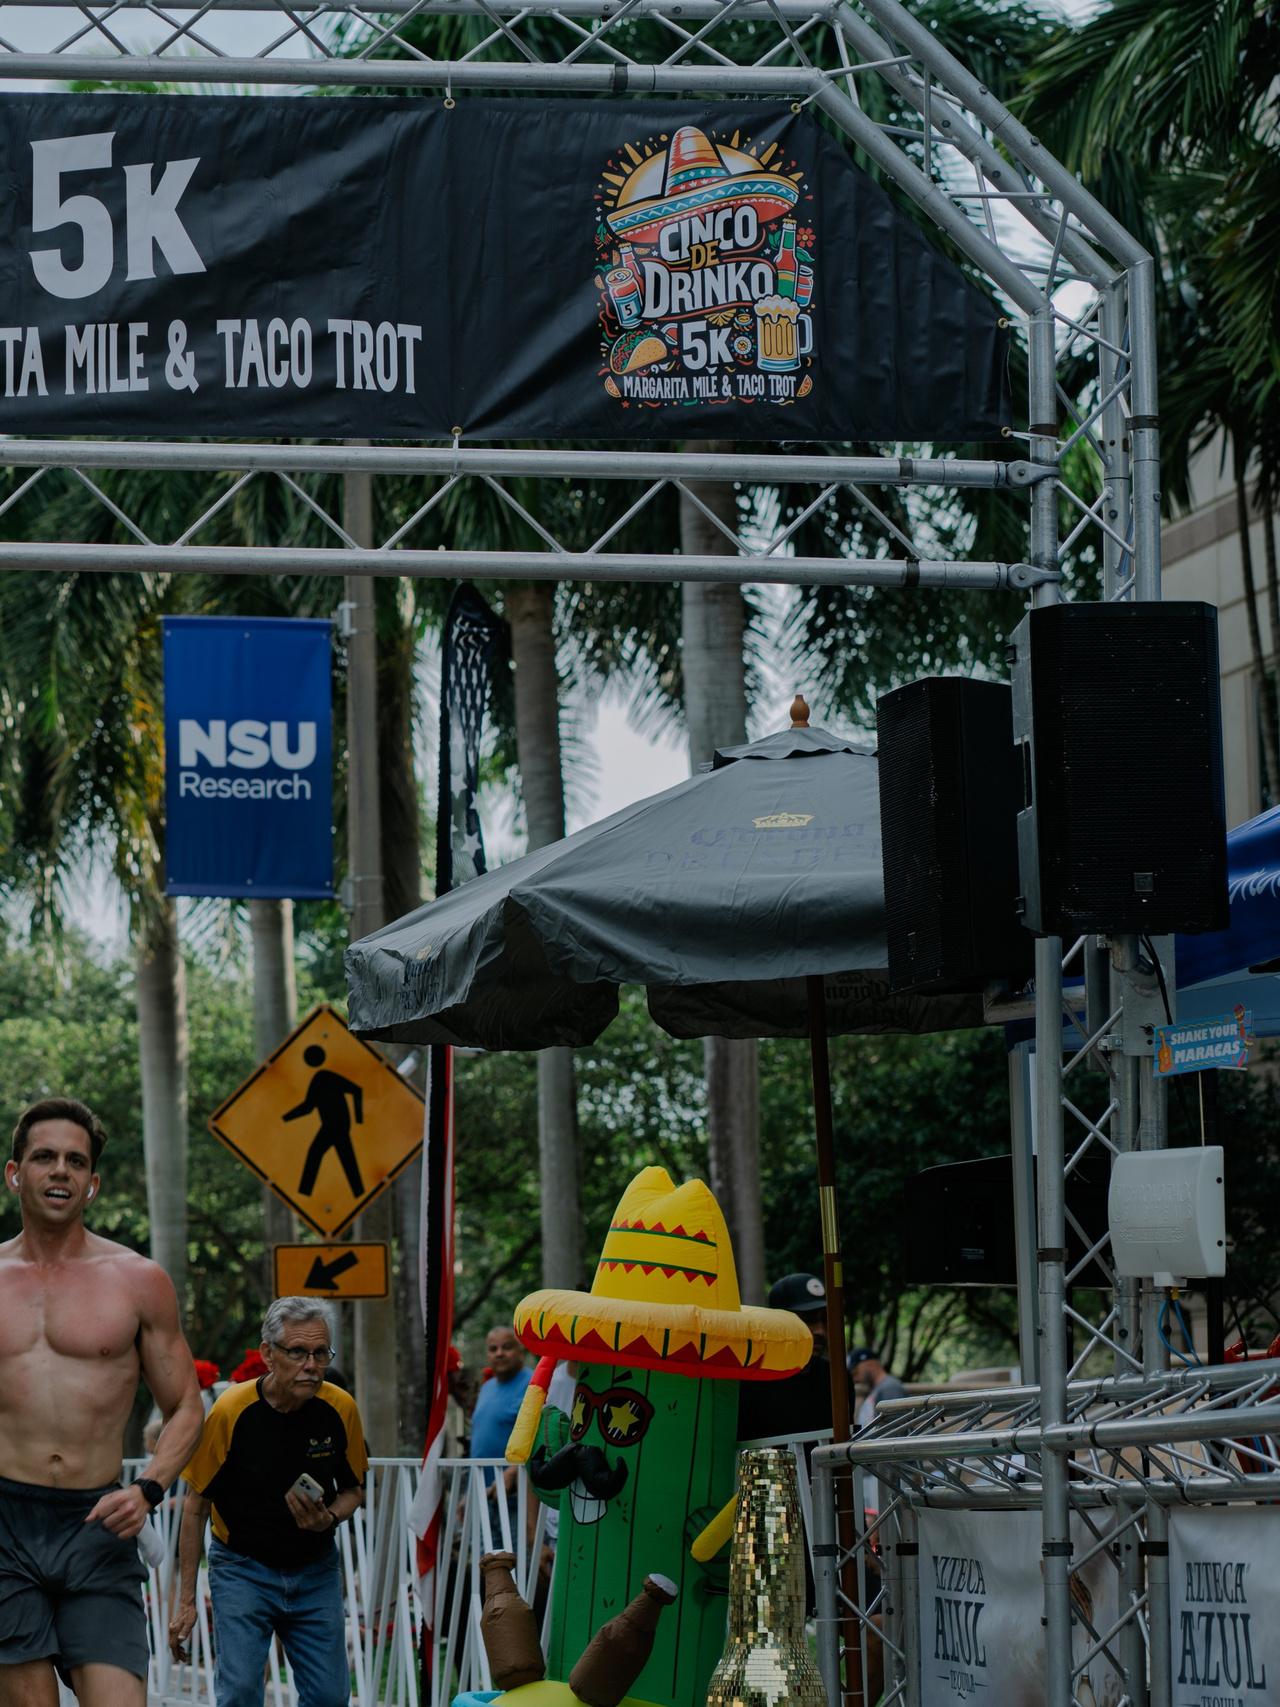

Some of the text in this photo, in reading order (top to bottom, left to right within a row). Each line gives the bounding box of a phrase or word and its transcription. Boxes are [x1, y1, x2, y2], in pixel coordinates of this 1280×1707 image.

[28, 131, 208, 299] 5K
[659, 205, 758, 262] CINCO
[690, 240, 720, 270] DE
[642, 261, 774, 318] DRINKO
[64, 321, 150, 396] MILE
[164, 318, 200, 394] &
[216, 316, 314, 389] TACO
[327, 317, 422, 395] TROT
[682, 320, 734, 370] 5K
[623, 374, 796, 399] MARGARITA MILE & TACO TROT
[179, 719, 317, 770] NSU
[179, 771, 312, 800] Research
[1170, 1024, 1238, 1045] SHAKE YOUR
[1174, 1040, 1241, 1064] MARACAS
[933, 1597, 987, 1668] AZUL
[1177, 1610, 1267, 1690] AZUL
